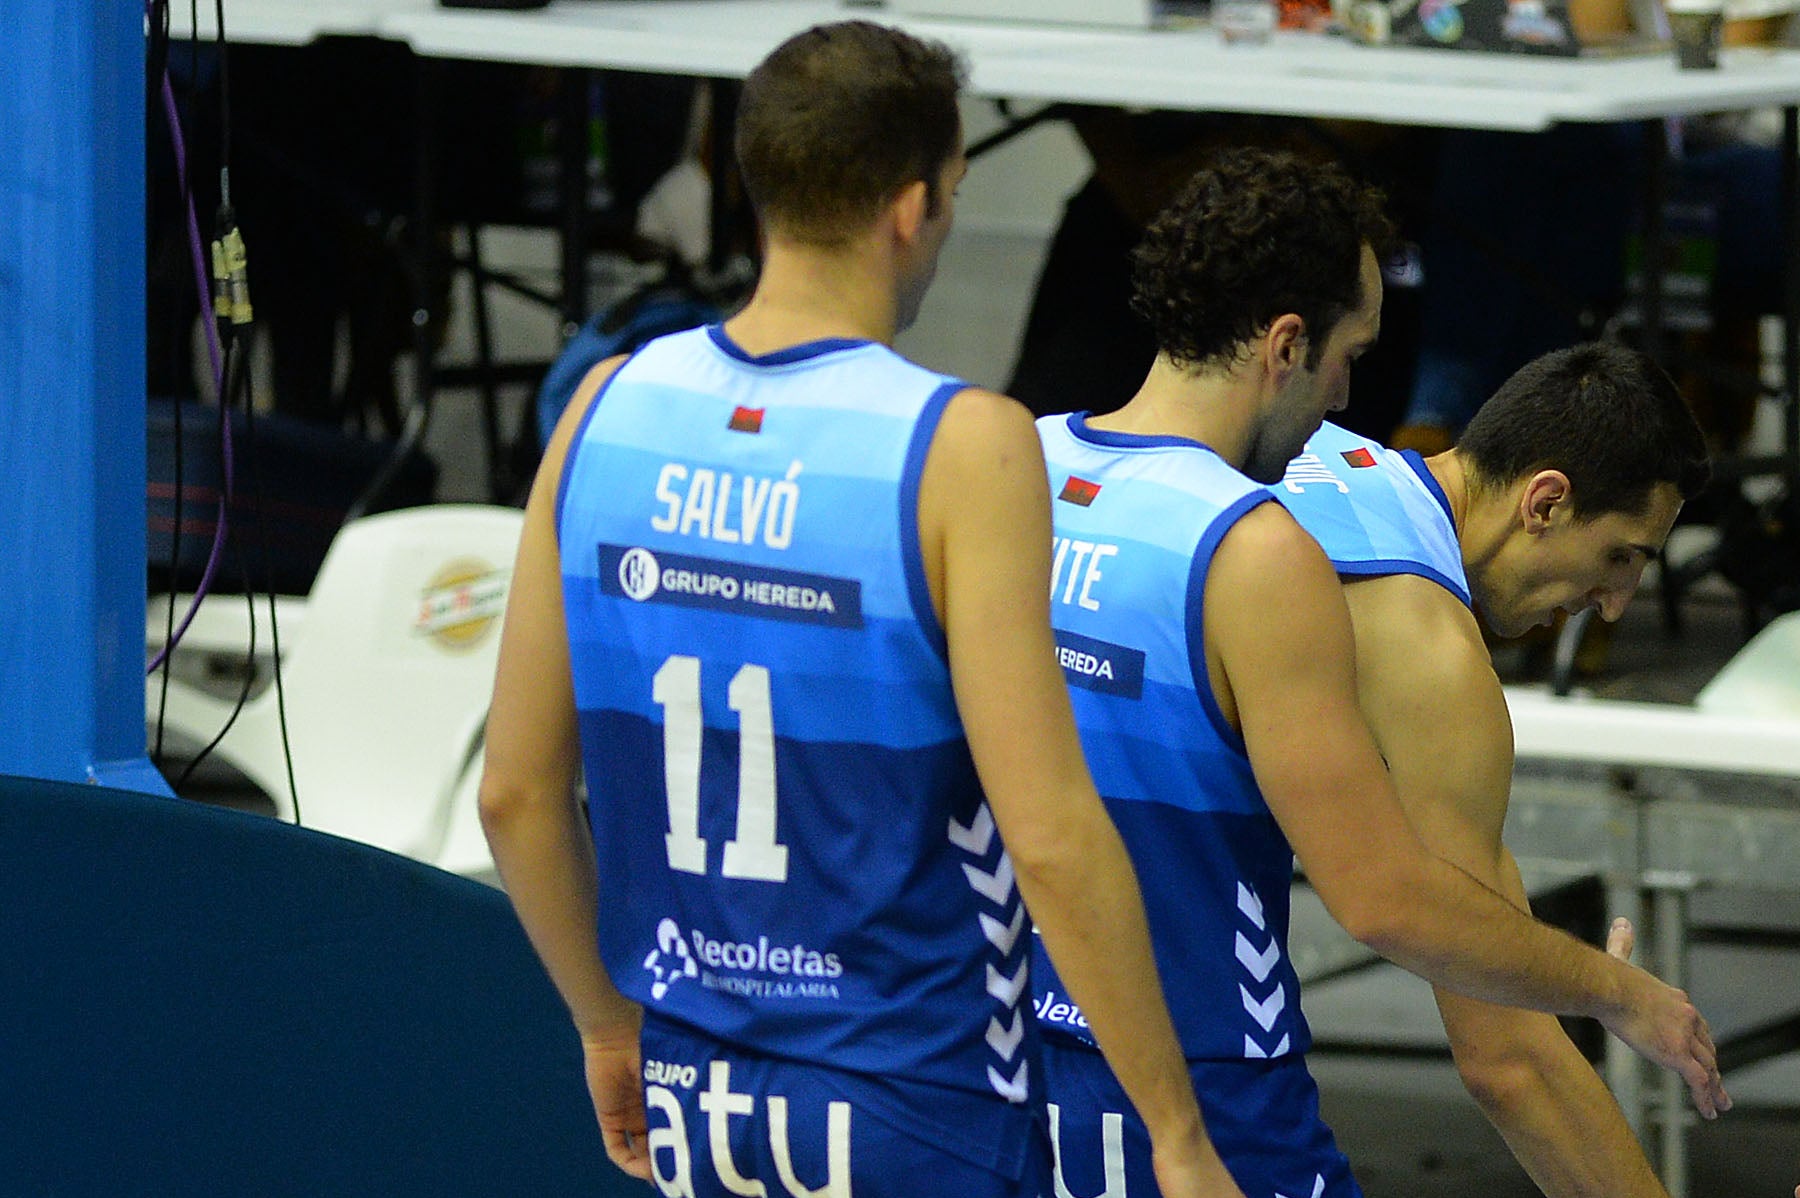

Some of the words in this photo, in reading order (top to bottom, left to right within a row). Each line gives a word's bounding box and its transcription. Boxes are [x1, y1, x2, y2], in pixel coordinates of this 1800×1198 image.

[651, 459, 804, 550] SALVÓ
[661, 568, 740, 600] GRUPO
[743, 579, 836, 614] HEREDA
[652, 654, 789, 884] 11
